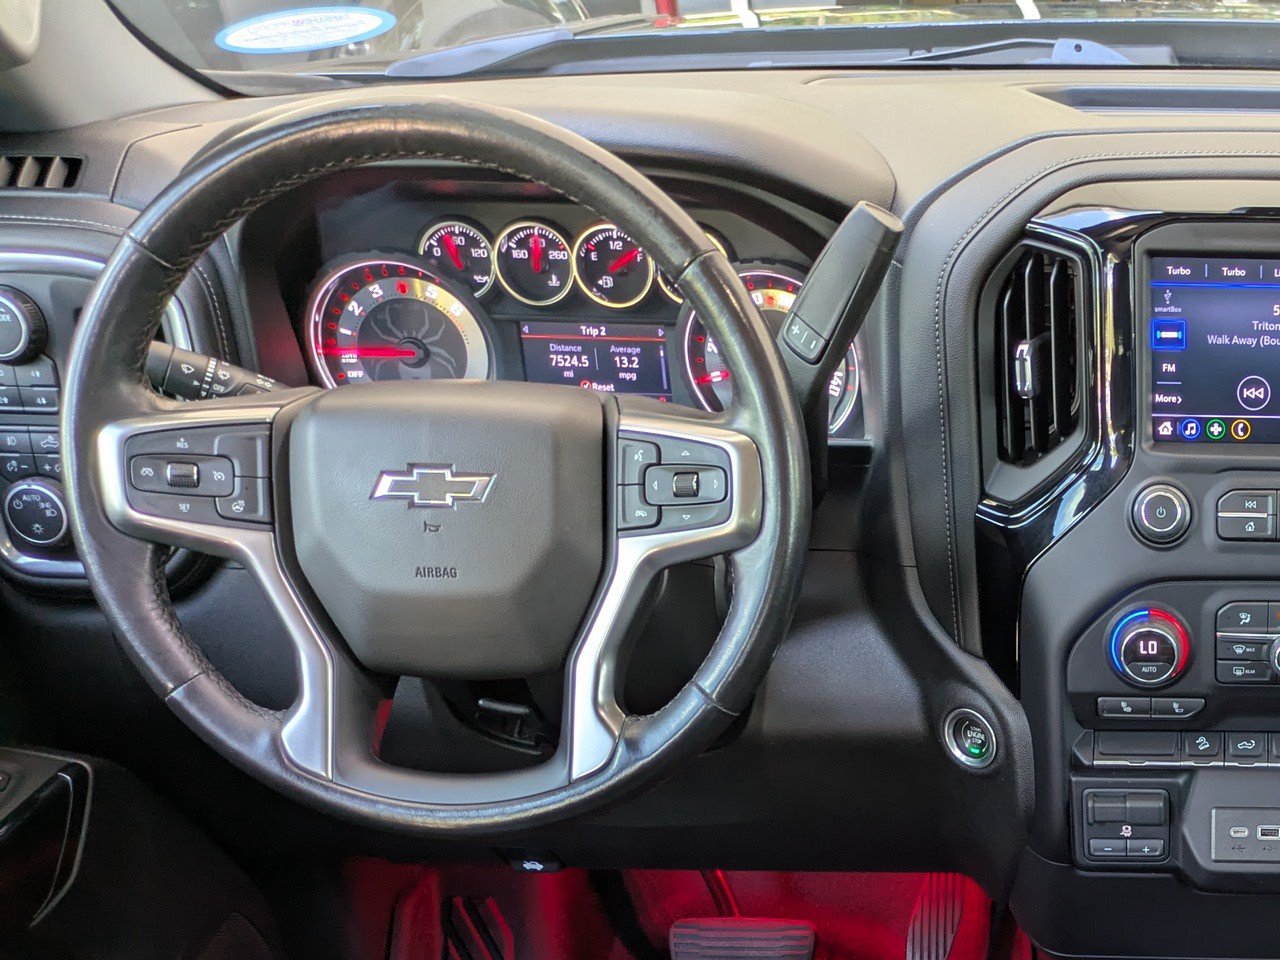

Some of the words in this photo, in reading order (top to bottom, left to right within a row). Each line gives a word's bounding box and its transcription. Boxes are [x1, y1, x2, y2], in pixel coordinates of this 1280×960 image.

[609, 240, 623, 251] 1/2
[433, 247, 441, 257] 0
[470, 248, 488, 258] 120
[511, 249, 528, 259] 160
[548, 250, 568, 260] 260
[590, 252, 598, 261] E
[637, 253, 643, 262] F
[1167, 266, 1191, 275] Turbo
[1222, 267, 1246, 277] Turbo
[368, 283, 383, 298] 3
[348, 301, 363, 316] 2
[1154, 305, 1182, 313] smartBox
[339, 327, 352, 336] 1
[580, 326, 598, 337] Trip
[600, 327, 606, 336] 2
[1207, 335, 1230, 345] Walk
[1232, 335, 1257, 348] Away
[550, 343, 582, 352] Distance
[610, 345, 641, 355] Average
[550, 355, 589, 368] 7524.5
[614, 356, 639, 368] 13.2
[1162, 363, 1176, 372] FM
[563, 370, 574, 378] mi
[619, 371, 637, 381] mpg
[592, 383, 615, 392] Reset
[829, 371, 844, 397] 140
[1155, 394, 1177, 403] More
[22, 494, 41, 502] AUTO
[415, 566, 458, 579] AIRBAG
[1140, 640, 1157, 655] LO
